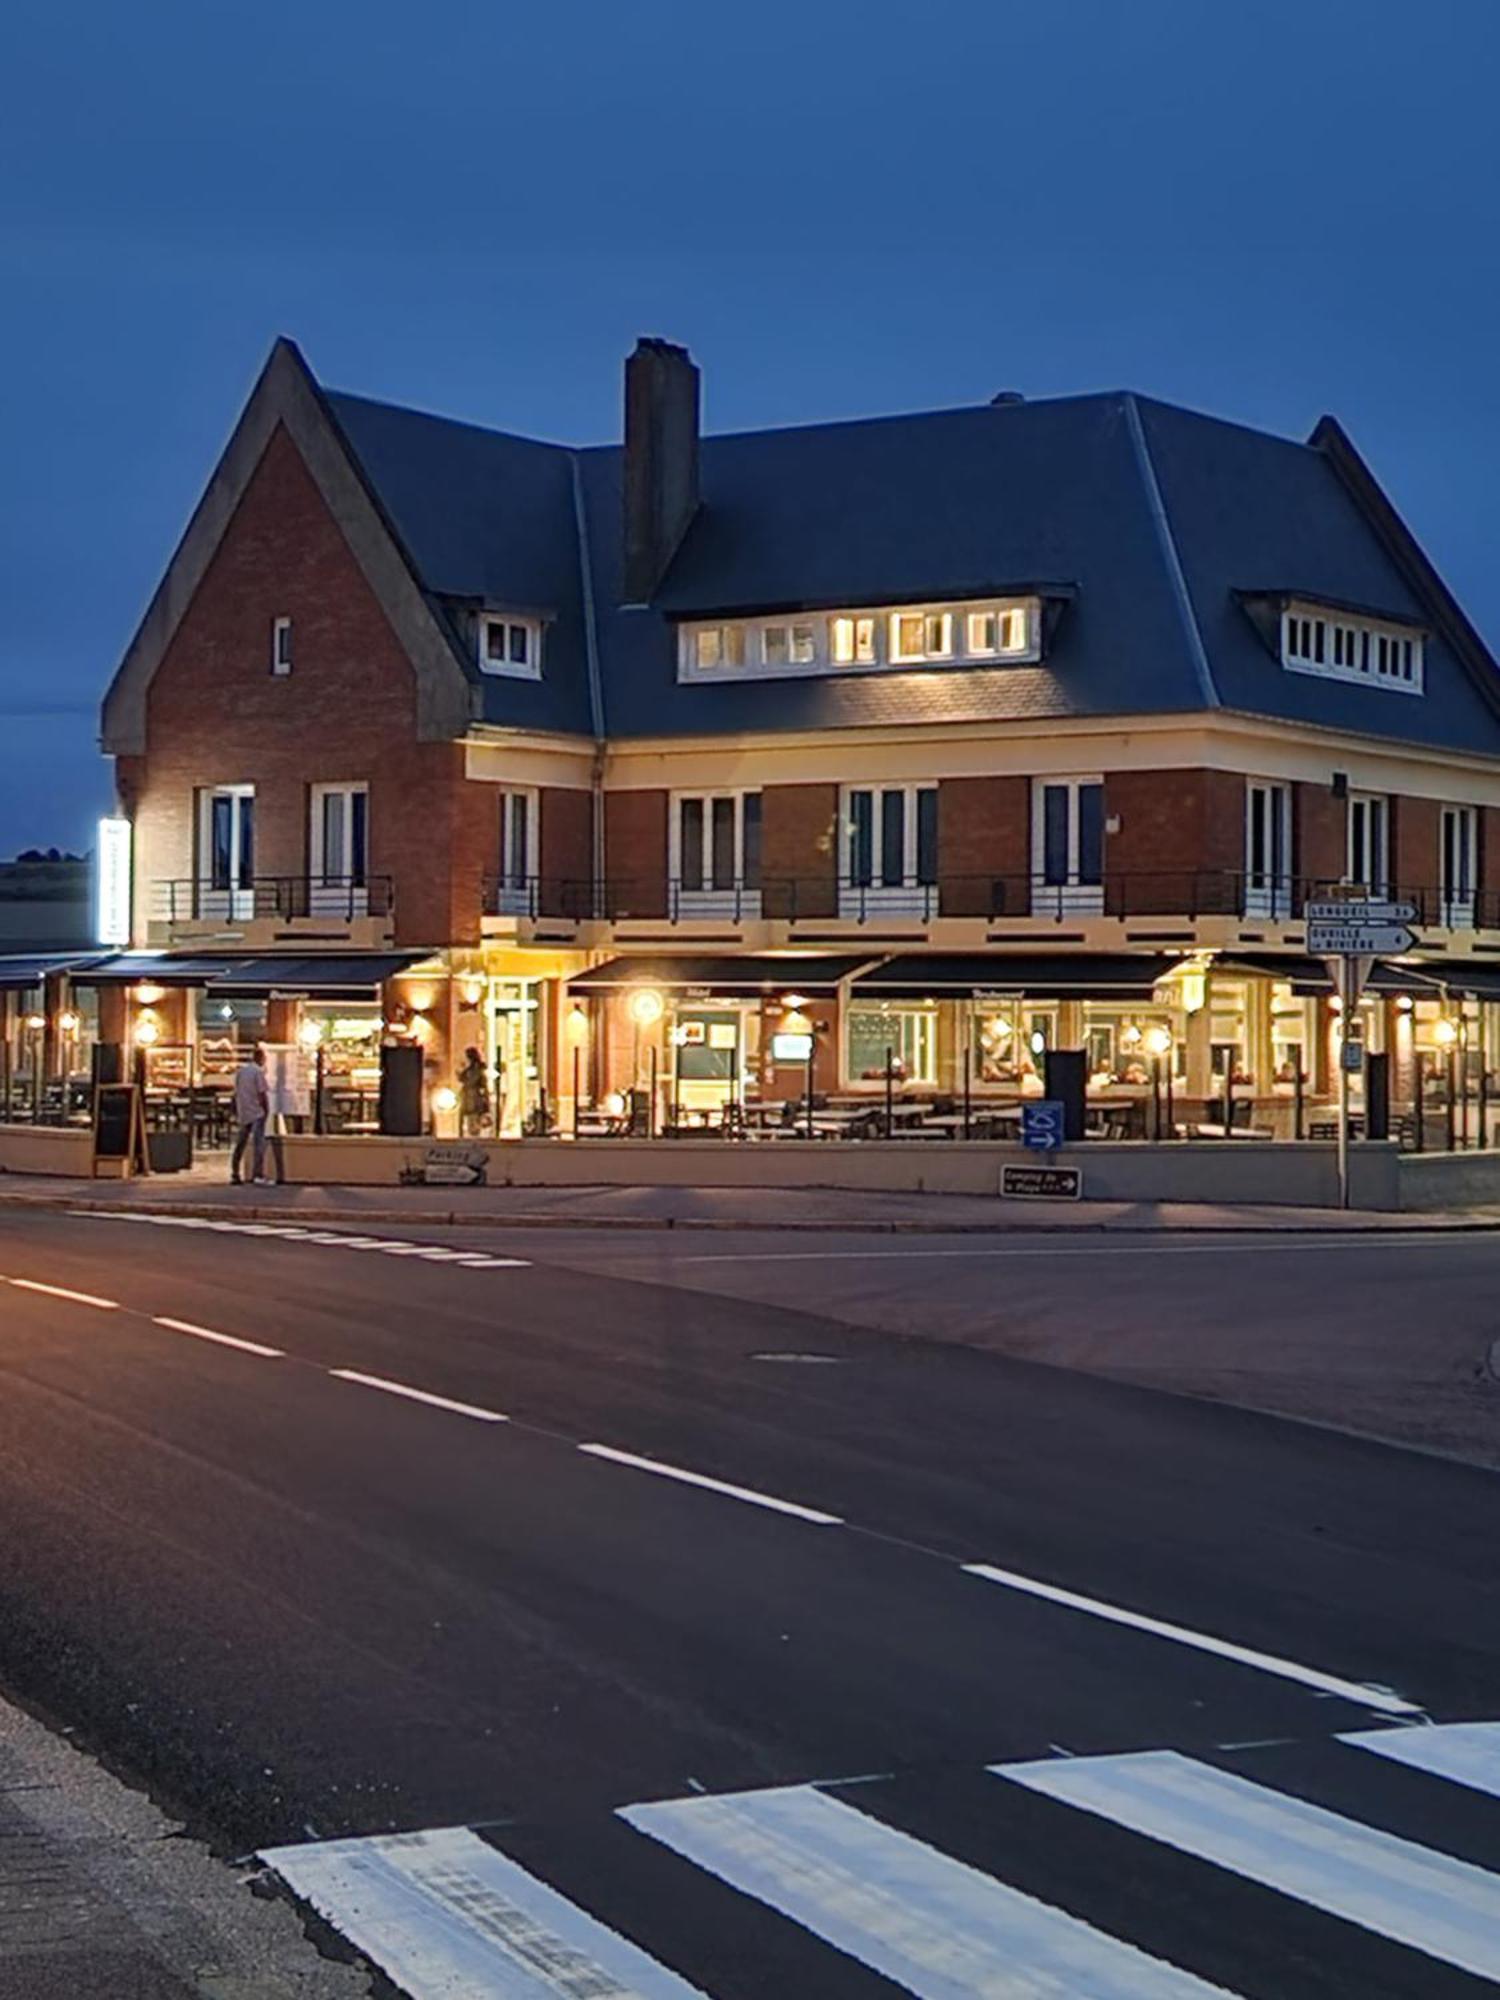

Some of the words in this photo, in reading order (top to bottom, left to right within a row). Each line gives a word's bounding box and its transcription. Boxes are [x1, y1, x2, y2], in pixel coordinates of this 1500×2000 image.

[1311, 906, 1369, 916] LONGUEIL
[1313, 928, 1360, 939] OUVILLE
[1326, 939, 1374, 950] RIVIÈRE
